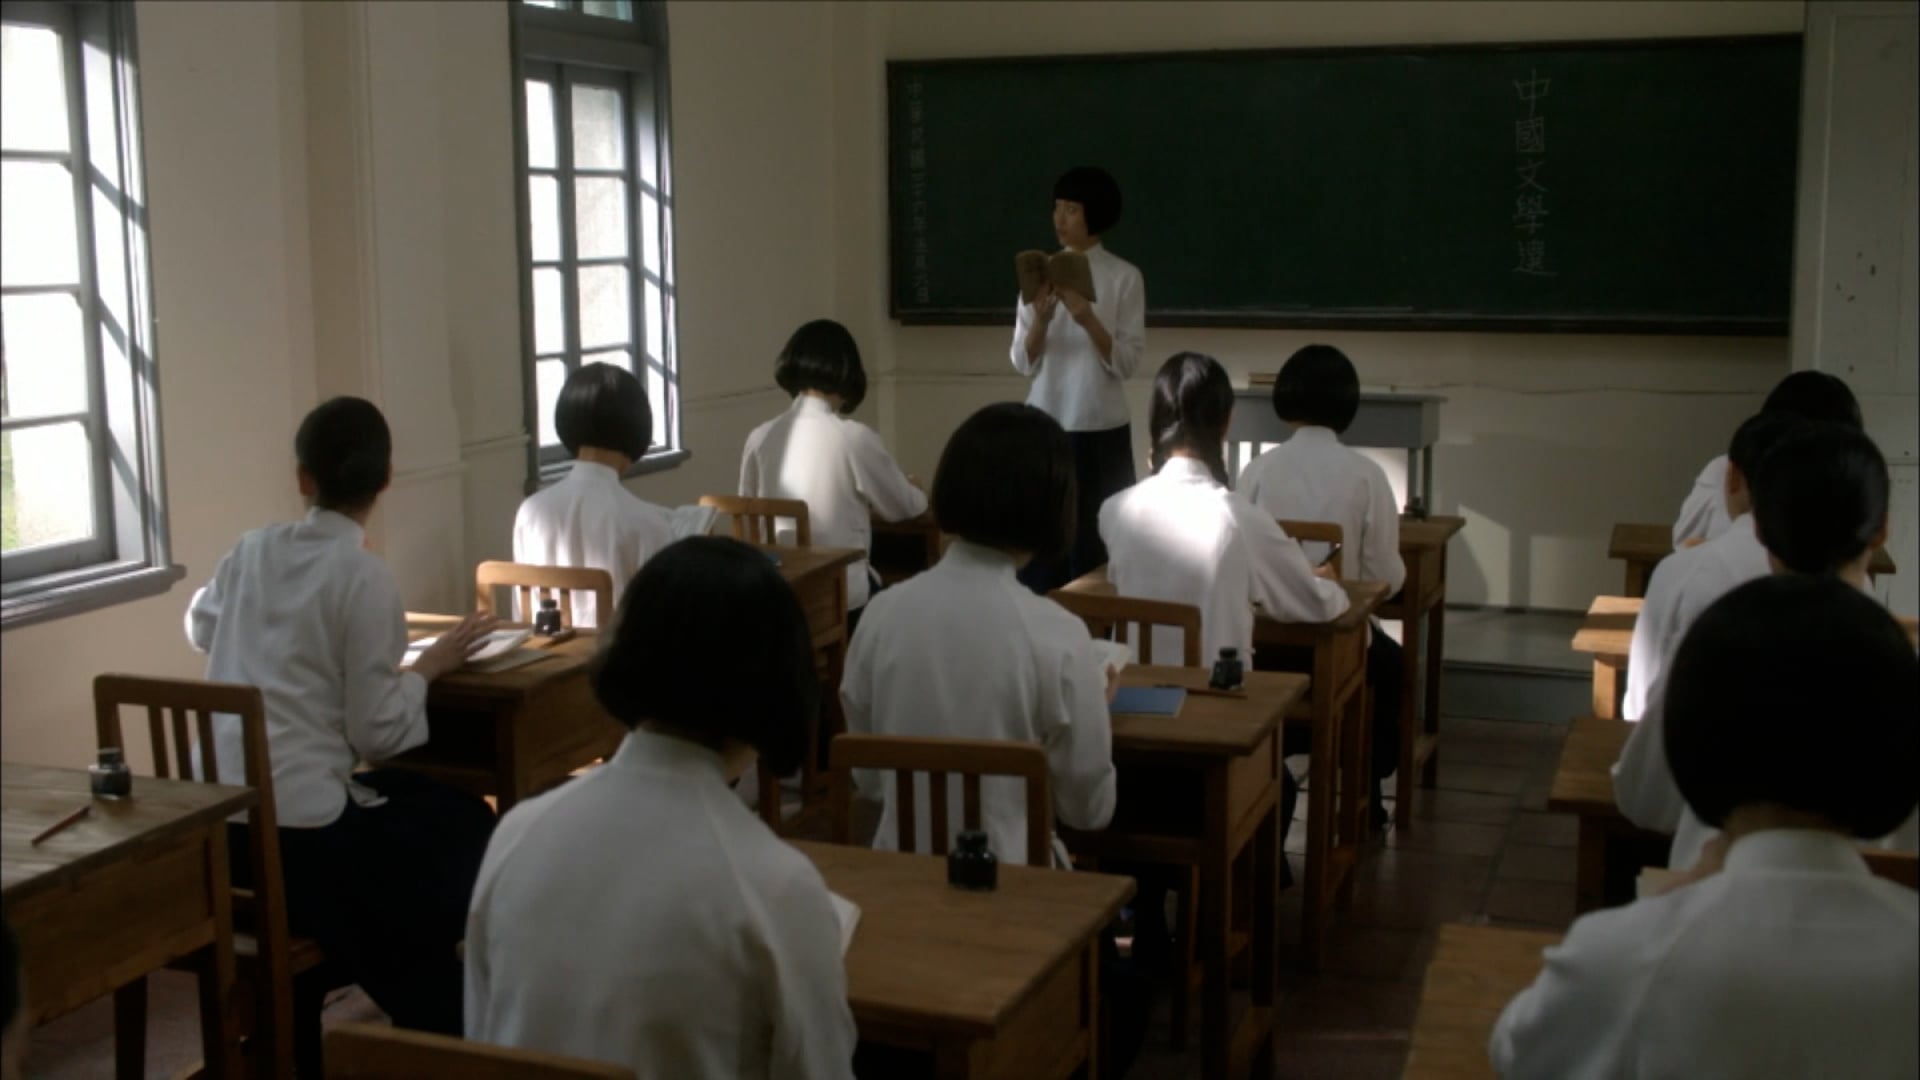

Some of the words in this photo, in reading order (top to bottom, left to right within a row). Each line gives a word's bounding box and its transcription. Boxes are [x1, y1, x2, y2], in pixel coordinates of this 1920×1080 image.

[1512, 67, 1559, 277] 中國文學選
